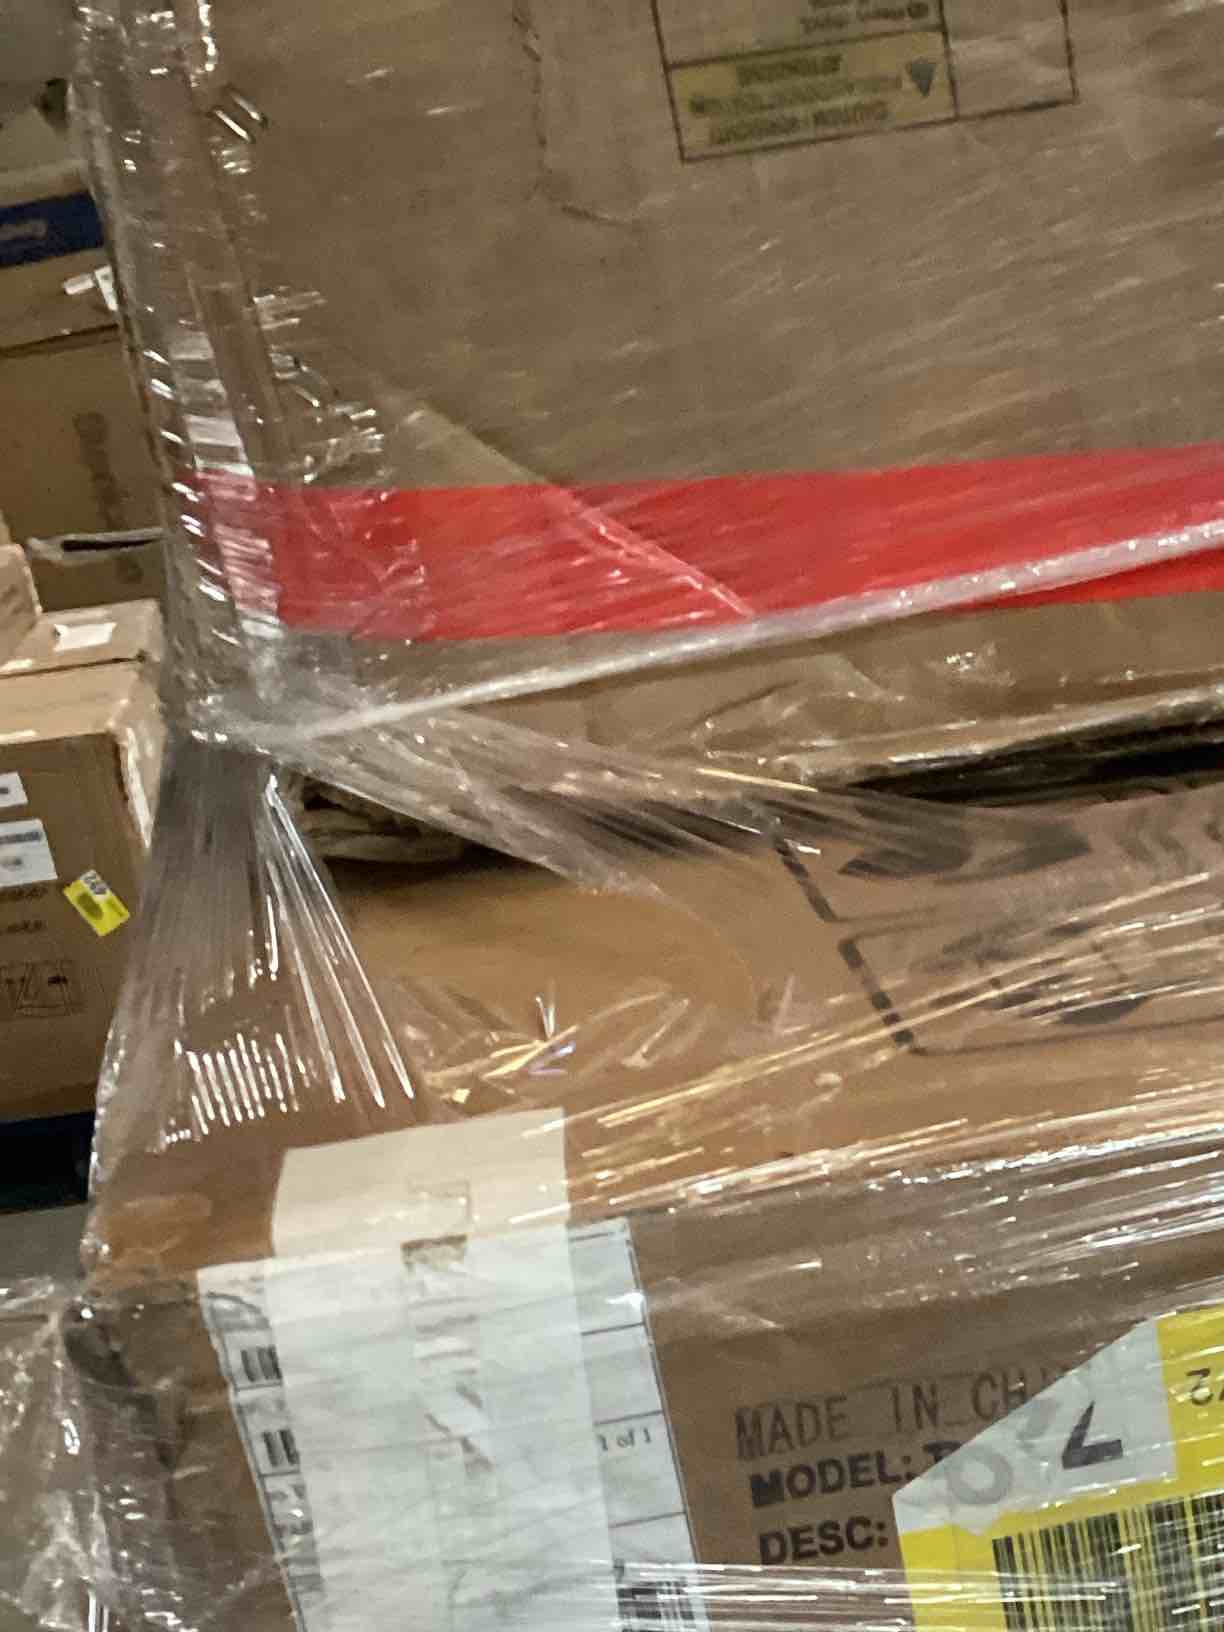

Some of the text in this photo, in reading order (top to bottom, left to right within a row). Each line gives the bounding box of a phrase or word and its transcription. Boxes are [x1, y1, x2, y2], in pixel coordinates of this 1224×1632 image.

[734, 1395, 848, 1462] MADE
[890, 1382, 938, 1433] IN
[748, 1449, 914, 1508] MODEL:
[758, 1514, 889, 1566] DESC:
